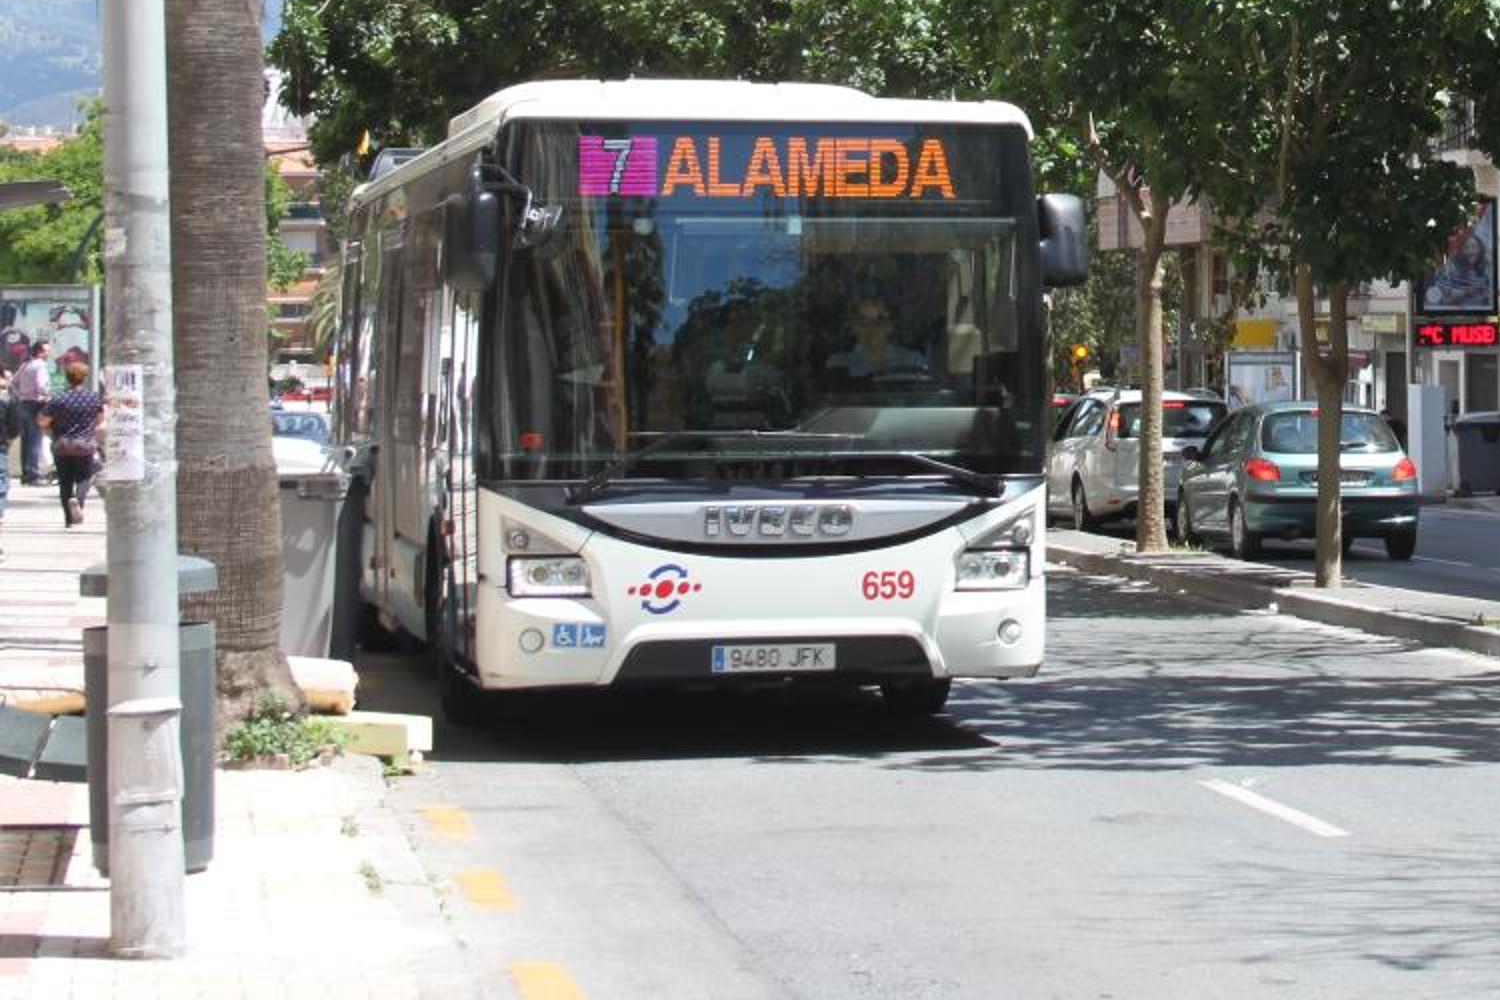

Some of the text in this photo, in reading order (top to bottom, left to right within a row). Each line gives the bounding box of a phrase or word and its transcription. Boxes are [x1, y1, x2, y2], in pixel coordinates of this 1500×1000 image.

[602, 135, 958, 200] 7 ALAMEDA
[704, 504, 858, 537] IVECO
[862, 570, 914, 600] 659
[730, 647, 825, 668] 9480 JFK
